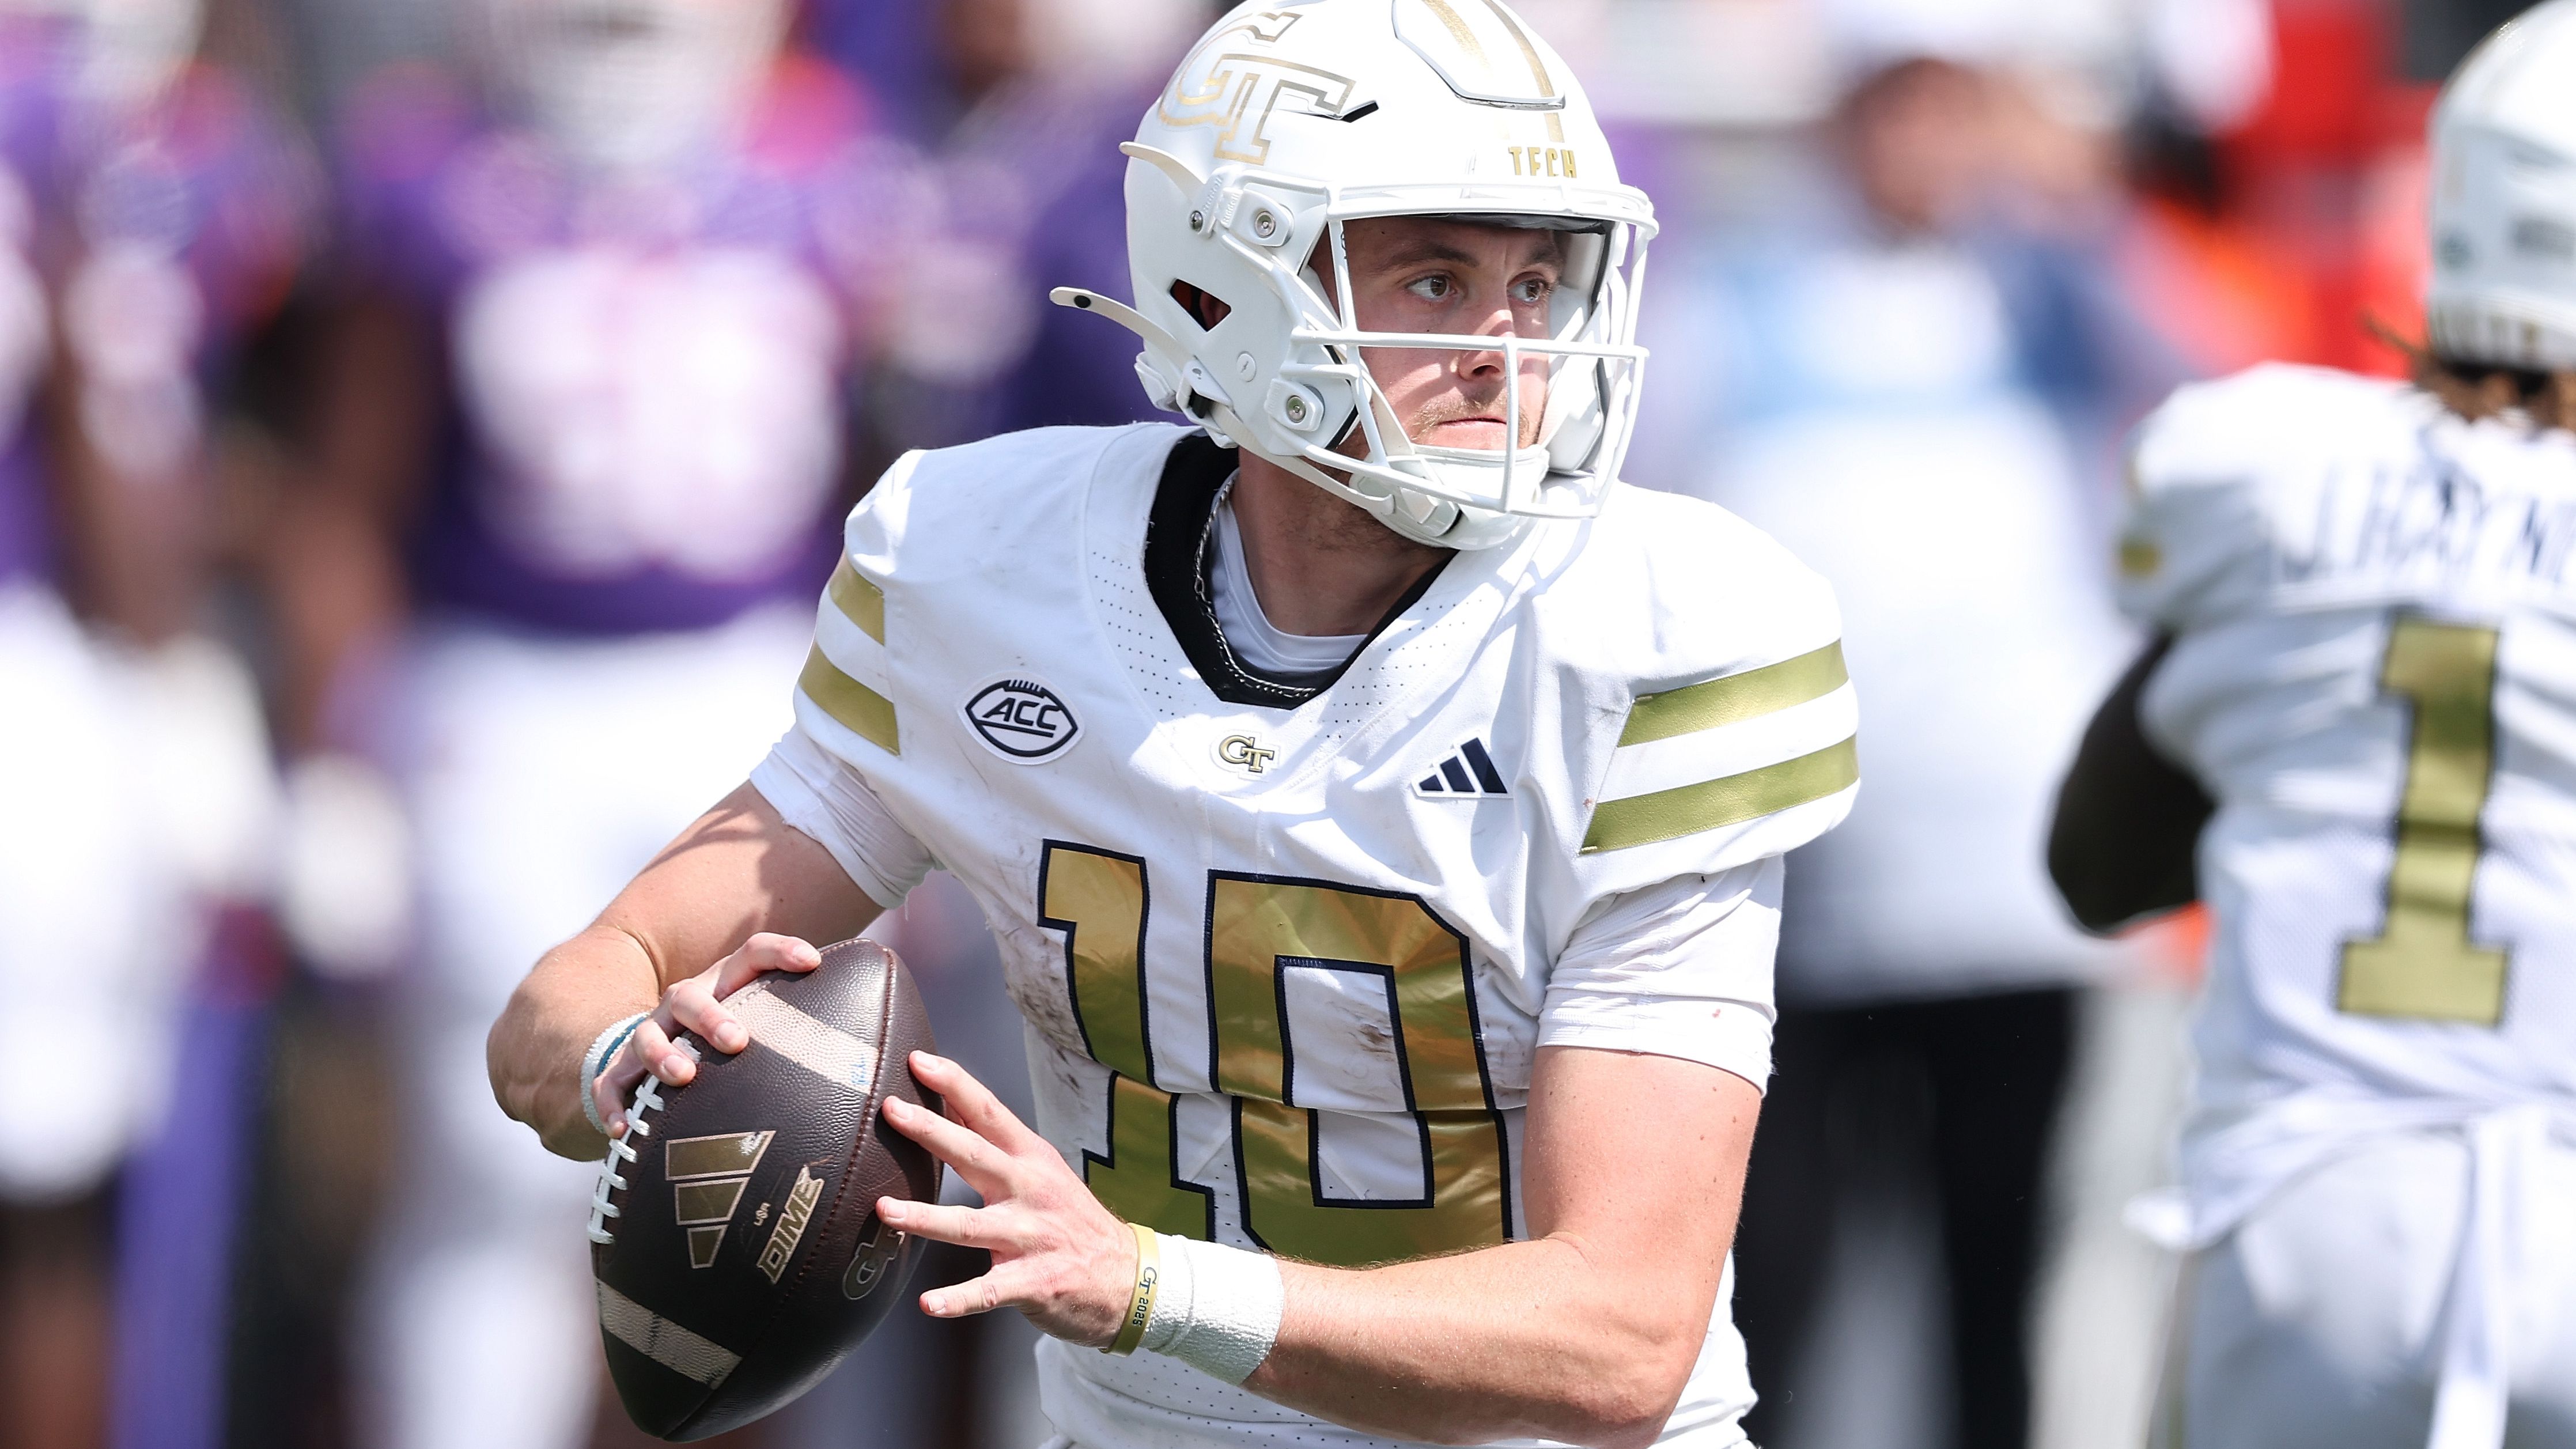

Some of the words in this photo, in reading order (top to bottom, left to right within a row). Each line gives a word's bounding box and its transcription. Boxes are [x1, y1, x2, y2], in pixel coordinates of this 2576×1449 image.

[1158, 11, 1356, 165] GT
[982, 697, 1060, 731] ACC
[1219, 735, 1274, 773] GT
[2331, 604, 2516, 1030] 1
[1037, 838, 1514, 1269] 10
[756, 1164, 825, 1284] DIME
[1139, 1266, 1157, 1295] GT
